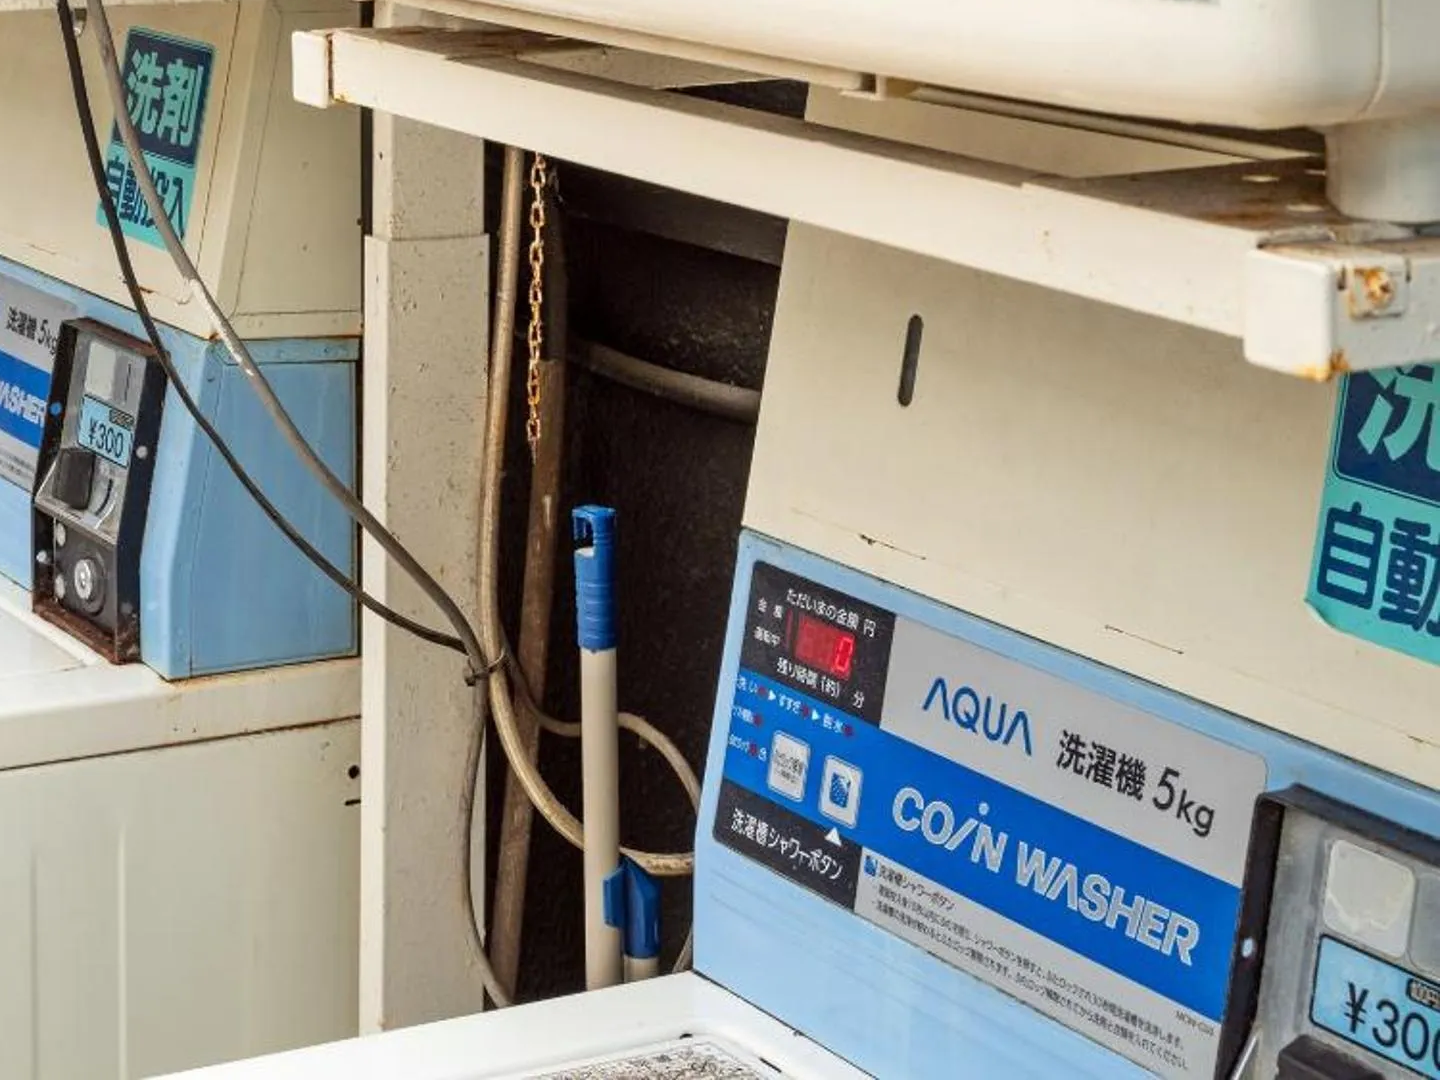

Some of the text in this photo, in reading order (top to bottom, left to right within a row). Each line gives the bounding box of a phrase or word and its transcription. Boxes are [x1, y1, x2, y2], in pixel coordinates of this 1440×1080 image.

[126, 49, 204, 148] 洗剤
[88, 416, 124, 459] ¥300
[863, 617, 877, 639] 円
[853, 690, 866, 709] 分
[921, 677, 1032, 757] AQUA
[1056, 730, 1215, 838] 洗濯機 5kg
[1014, 840, 1200, 967] WASHER
